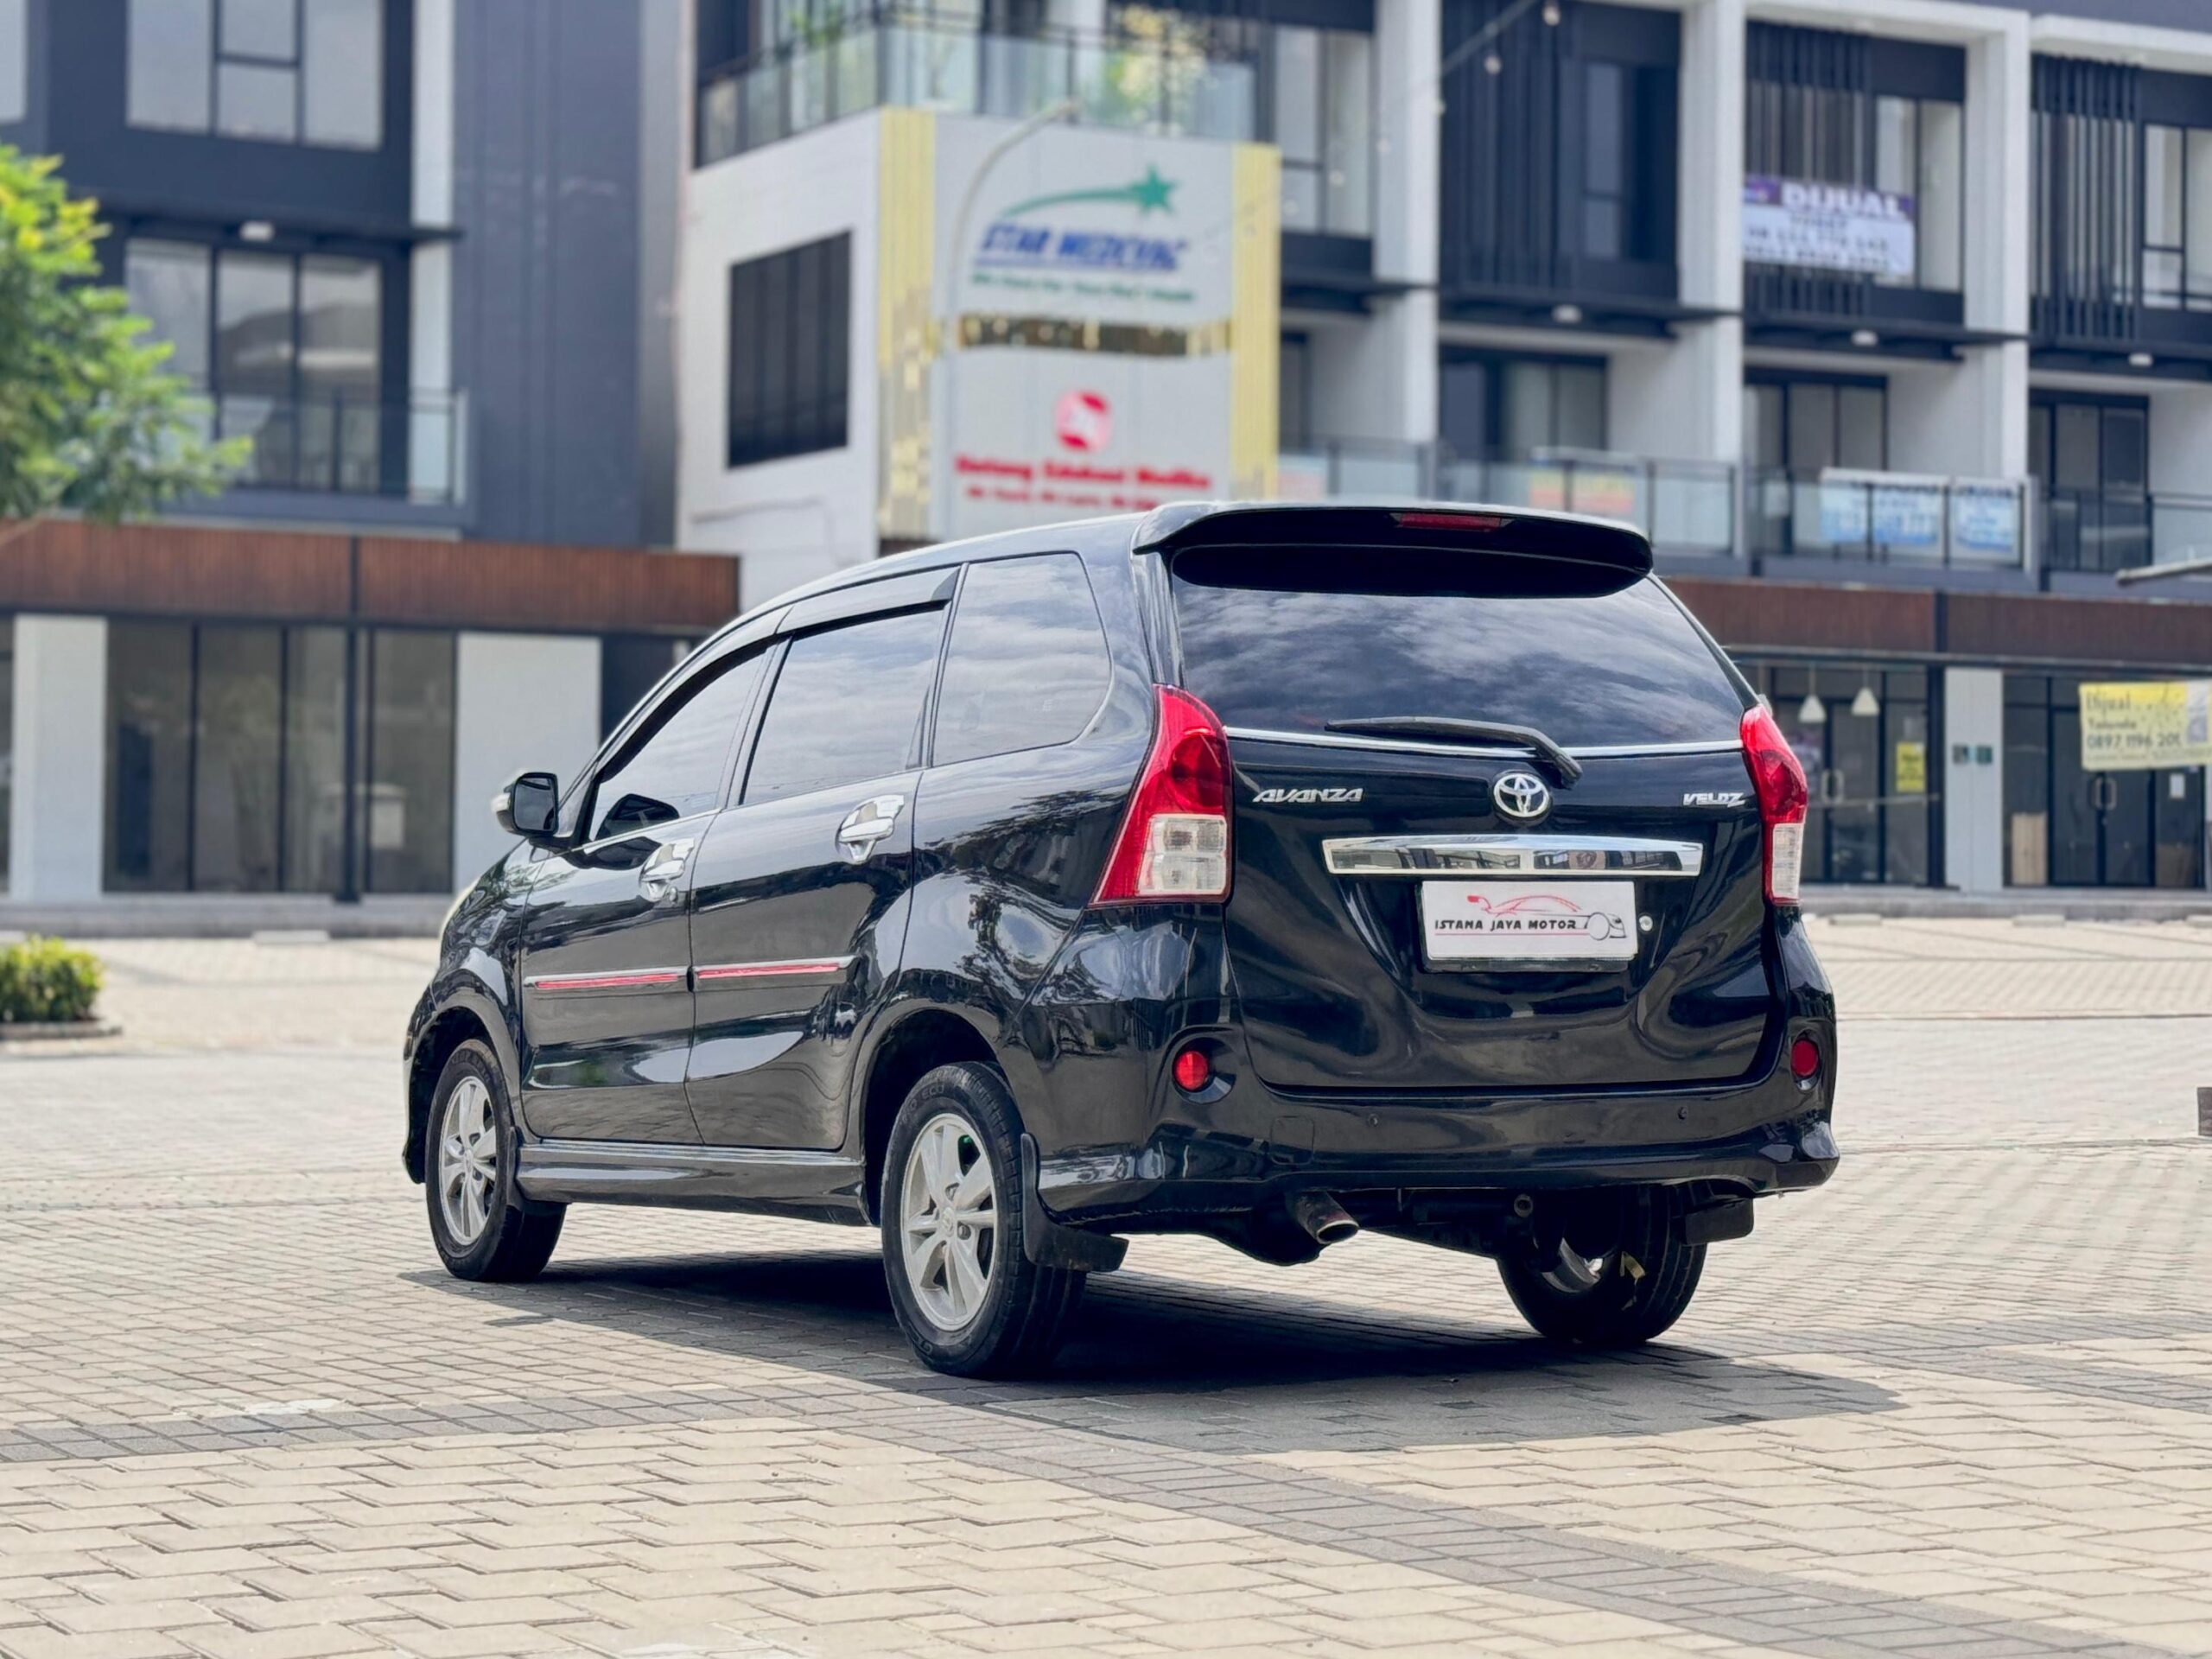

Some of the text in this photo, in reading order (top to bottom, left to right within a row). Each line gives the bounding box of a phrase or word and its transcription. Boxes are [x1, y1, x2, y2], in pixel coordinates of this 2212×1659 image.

[1253, 788, 1363, 803] AVANZA
[1434, 919, 1576, 932] ISTANA JAYA MOTOR
